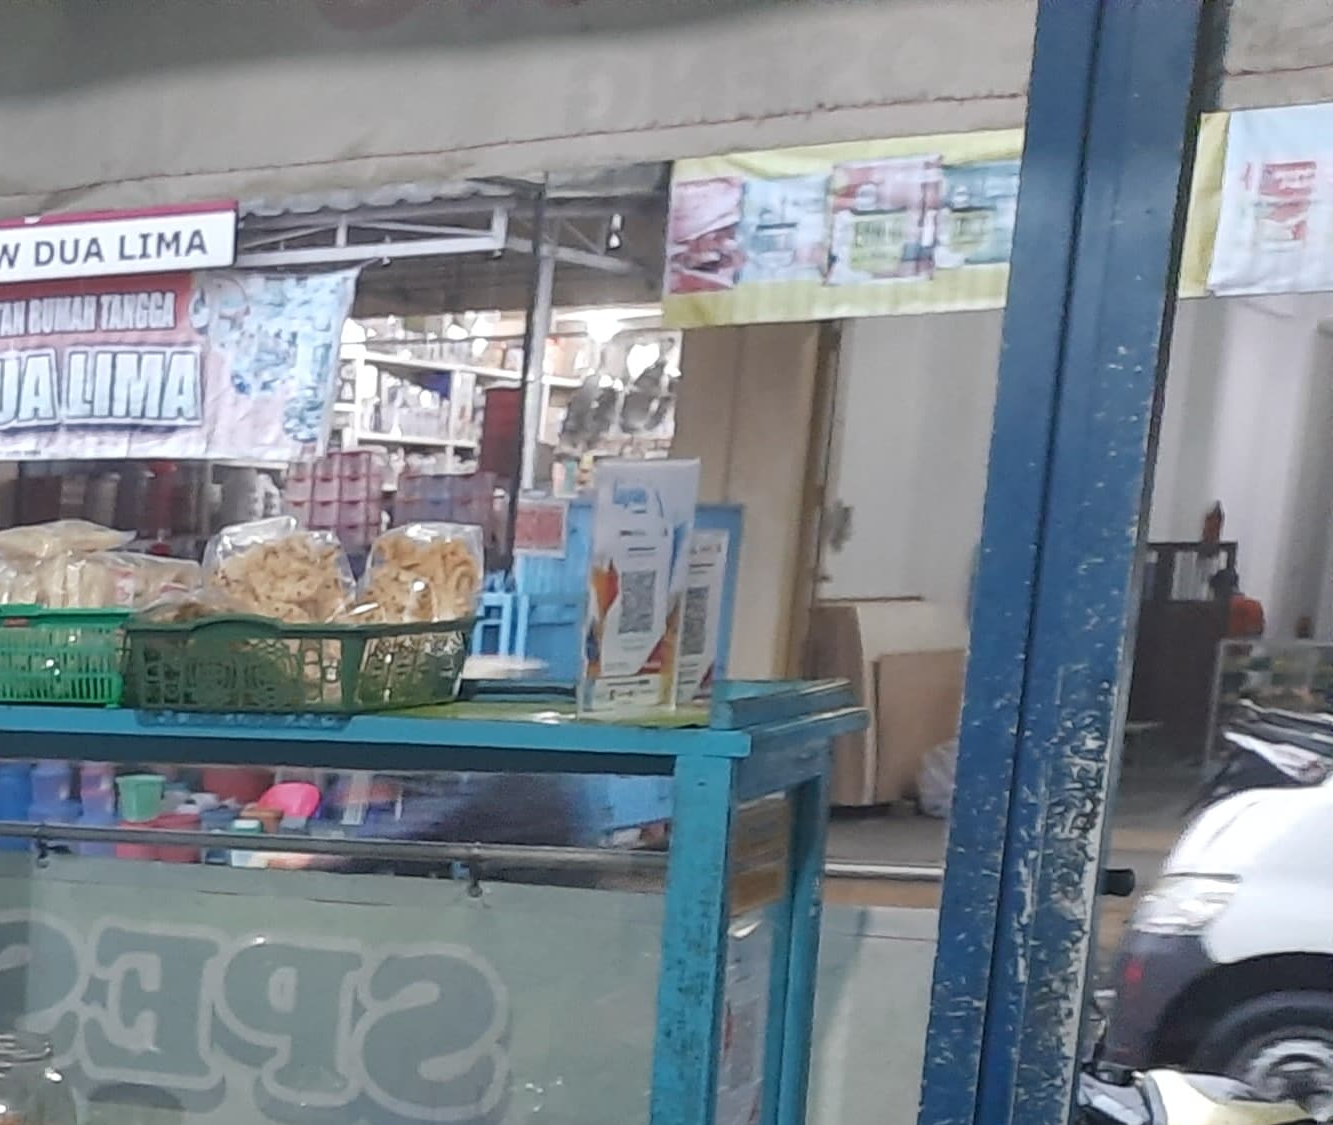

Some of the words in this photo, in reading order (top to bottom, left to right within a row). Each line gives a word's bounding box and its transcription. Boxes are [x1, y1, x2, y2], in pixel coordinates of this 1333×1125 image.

[33, 237, 105, 266] DUA
[118, 228, 208, 261] LIMA
[62, 348, 202, 426] LIMA
